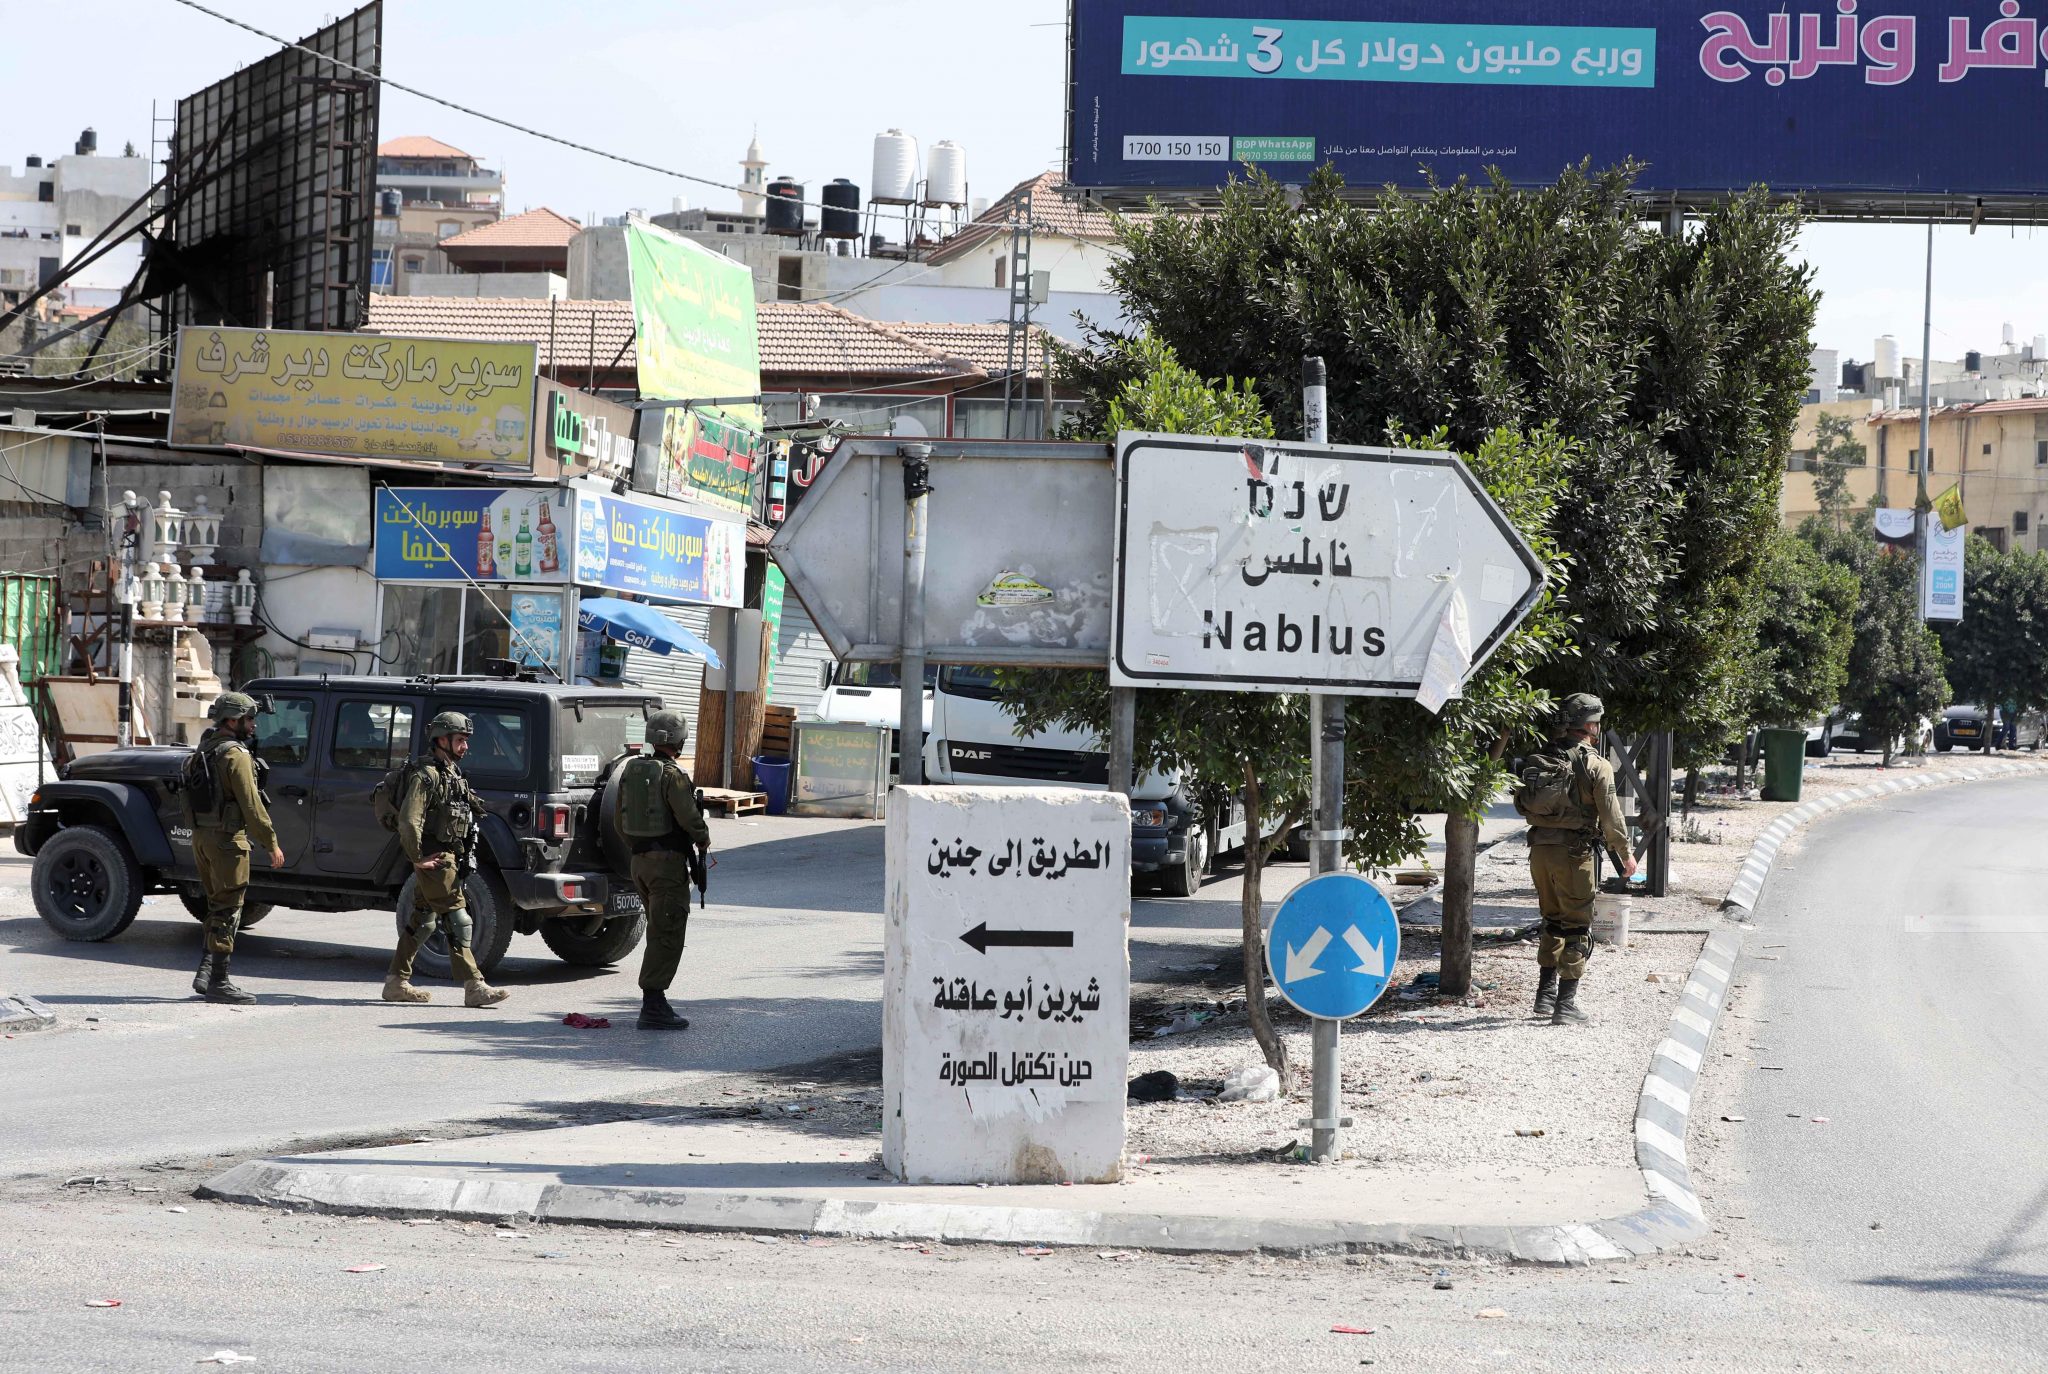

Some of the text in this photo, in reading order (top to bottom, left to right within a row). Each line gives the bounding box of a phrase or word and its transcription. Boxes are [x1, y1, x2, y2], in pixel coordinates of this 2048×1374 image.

[1699, 0, 2048, 87] فر ونربح
[1136, 25, 1643, 76] وربع مليون دولار كل 3 شهور
[1129, 142, 1221, 156] 1700 150 150
[1258, 140, 1313, 150] WhatsApp
[1345, 146, 1358, 155] من
[1359, 145, 1376, 154] معنا
[1377, 145, 1409, 156] التواصل
[1410, 145, 1438, 157] يمكنكم
[1439, 146, 1480, 156] المعلومات
[1481, 146, 1494, 157] من
[1496, 146, 1517, 156] لمزيد
[1262, 152, 1278, 160] 593
[1279, 152, 1295, 161] 666
[1296, 152, 1312, 161] 666
[196, 331, 522, 400] سوبر ماركت دير شرف
[611, 505, 636, 553] حيفا
[402, 530, 451, 569] حيفا
[1242, 536, 1352, 587] نابلس
[579, 612, 597, 625] olf
[624, 629, 657, 649] Golf
[1203, 610, 1386, 656] Nablus
[951, 748, 992, 760] DAF
[170, 825, 193, 838] Jeep
[927, 836, 1110, 880] الطريق إلى جنين
[933, 976, 1100, 1023] شيرين أبو عاقلة
[939, 1051, 1092, 1087] حين تكتمل الصورة
